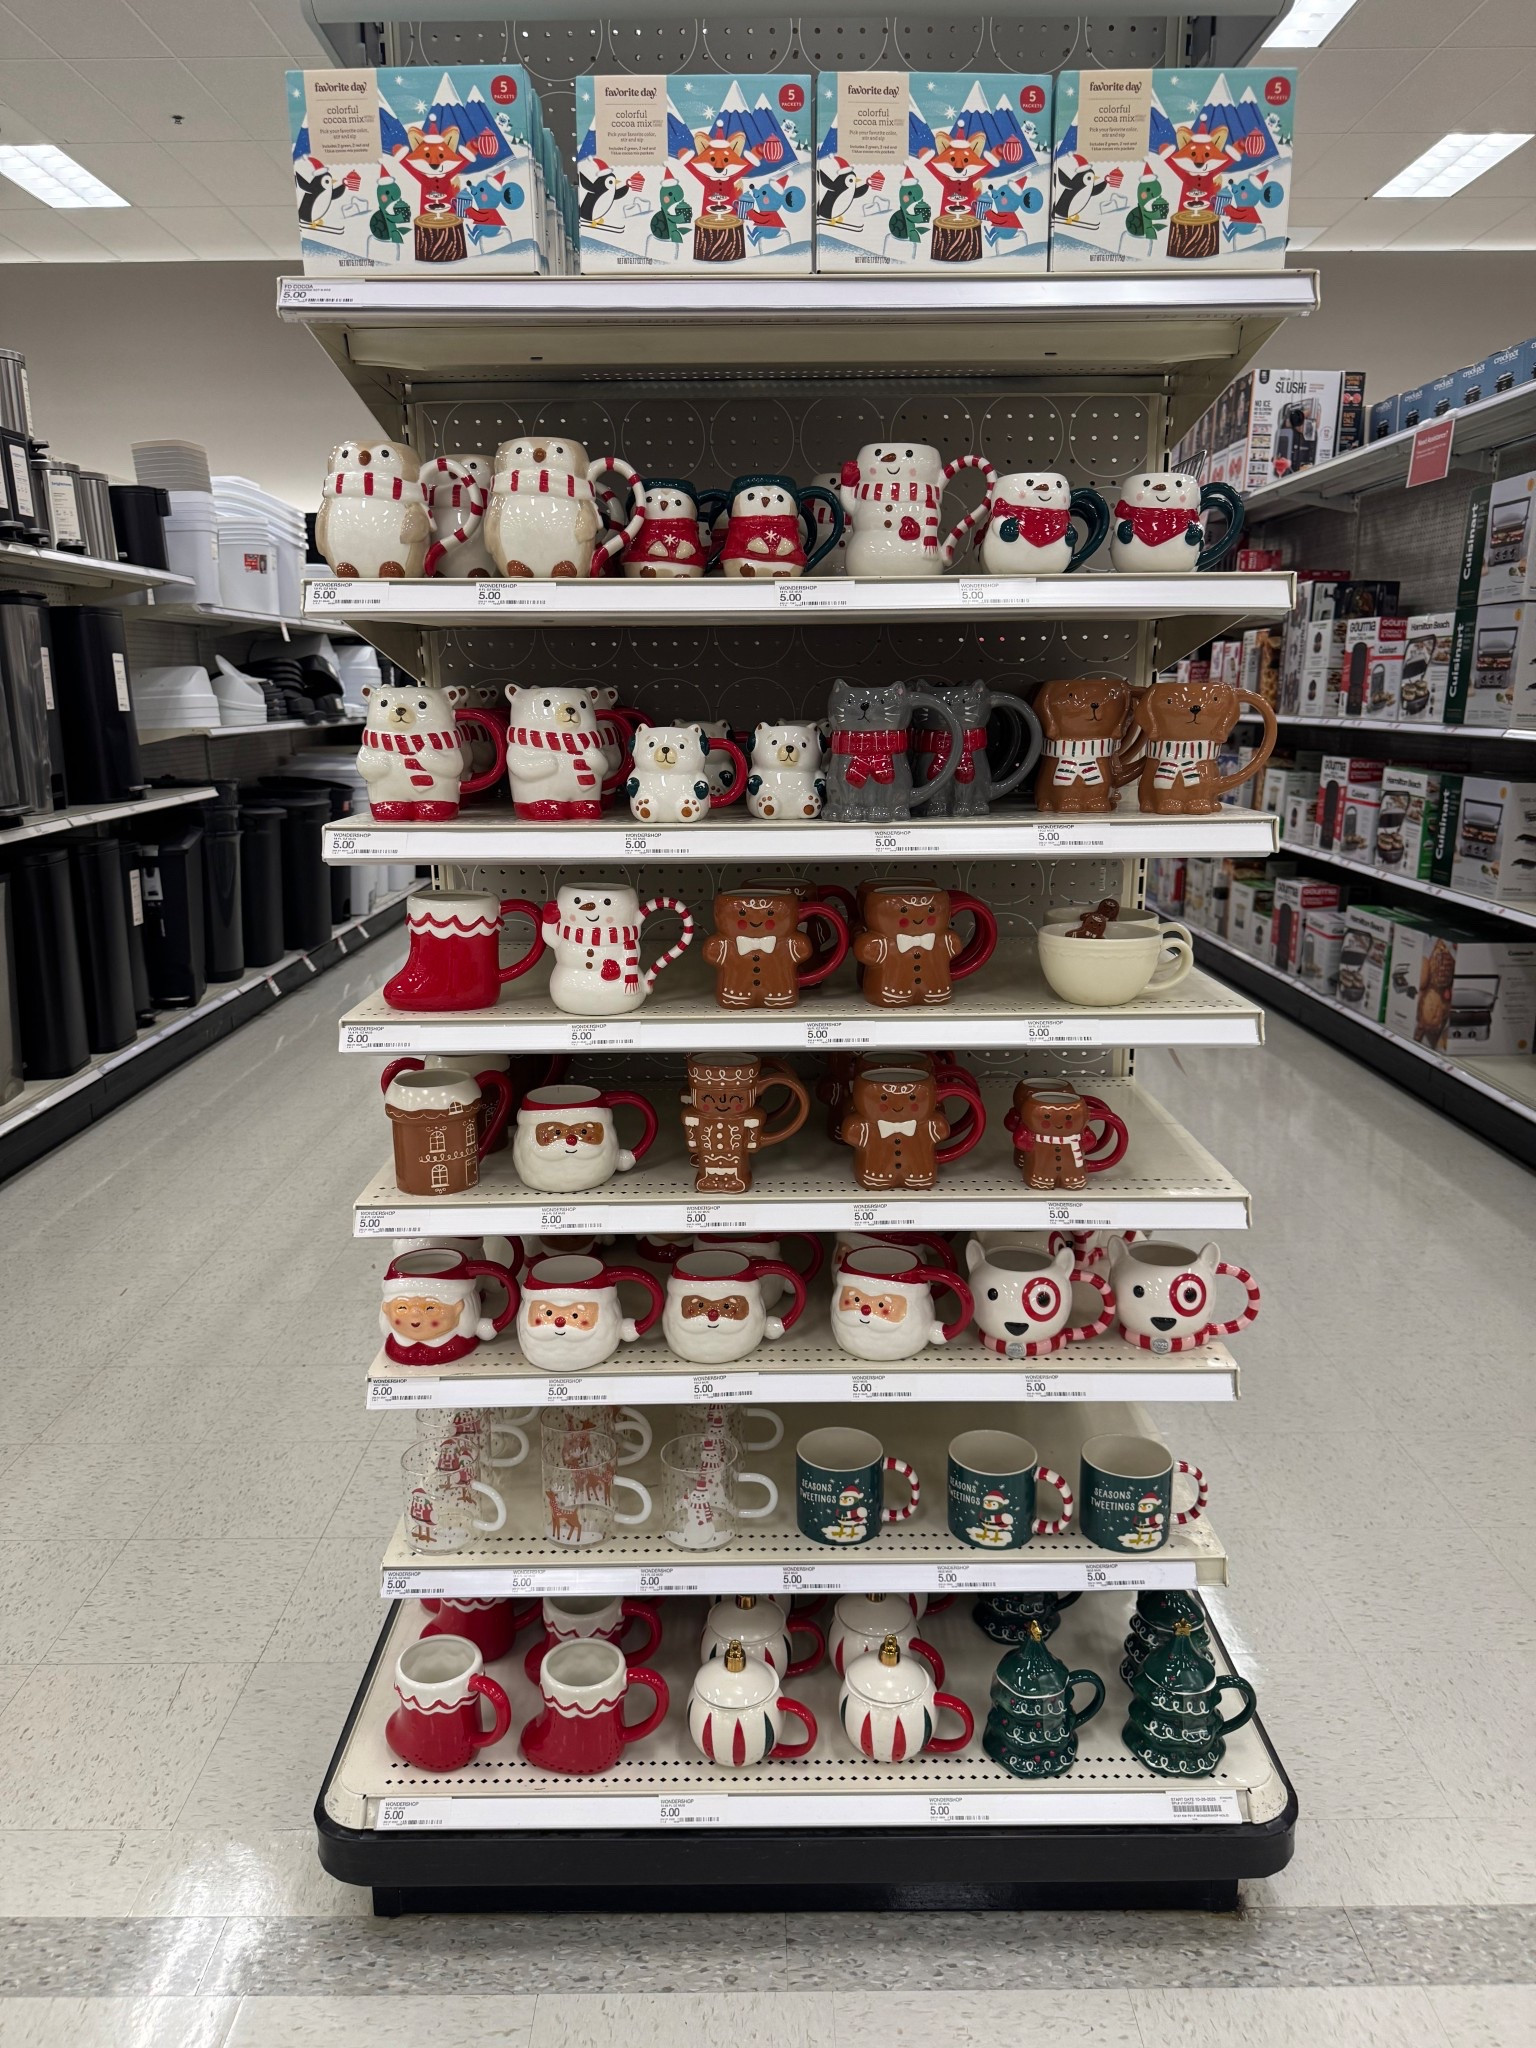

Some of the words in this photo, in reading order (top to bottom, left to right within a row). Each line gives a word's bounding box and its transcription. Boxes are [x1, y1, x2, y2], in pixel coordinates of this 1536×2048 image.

[315, 82, 350, 92] favorite
[351, 82, 367, 93] day
[501, 81, 508, 92] 5
[1090, 82, 1124, 91] favorite
[1125, 81, 1142, 93] day
[1274, 82, 1282, 94] 5
[605, 87, 639, 97] favorite
[641, 88, 657, 99] day
[788, 89, 795, 100] 5
[848, 85, 882, 95] favorite
[883, 86, 900, 98] day
[1029, 91, 1036, 102] 5
[327, 105, 359, 114] colorful
[858, 109, 889, 117] colorful
[1099, 105, 1130, 114] colorful
[616, 110, 647, 119] colorful
[323, 116, 347, 124] cocoa
[349, 115, 364, 123] mix
[1463, 503, 1478, 580] Cuisinart
[313, 591, 336, 599] 5.00
[478, 591, 501, 600] 5.00
[780, 594, 802, 602] 5.00
[962, 591, 984, 600] 5.00
[1449, 623, 1464, 697] Cuisinart
[1435, 790, 1450, 860] Cuisinart
[1038, 832, 1060, 840] 5.00
[875, 838, 896, 846] 5.00
[572, 1032, 592, 1040] 5.00
[807, 1030, 828, 1038] 5.00
[1028, 1028, 1049, 1037] 5.00
[347, 1034, 368, 1042] 5.00
[686, 1214, 706, 1222] 5.00
[854, 1212, 874, 1220] 5.00
[1050, 1210, 1069, 1218] 5.00
[360, 1219, 380, 1227] 5.00
[542, 1215, 562, 1224] 5.00
[373, 1386, 392, 1395] 5.00
[548, 1387, 568, 1395] 5.00
[694, 1384, 713, 1393] 5.00
[852, 1384, 872, 1392] 5.00
[1026, 1382, 1046, 1391] 5.00
[1094, 1487, 1131, 1499] SEASONS
[1091, 1497, 1135, 1511] TWEETINGS
[640, 1576, 660, 1585] 5.00
[783, 1575, 802, 1583] 5.00
[938, 1573, 957, 1582] 5.00
[1087, 1572, 1106, 1581] 5.00
[387, 1580, 406, 1589] 5.00
[512, 1577, 532, 1586] 5.00
[384, 1810, 404, 1819] 5.00
[660, 1807, 680, 1817] 5.00
[930, 1806, 950, 1815] 5.00
